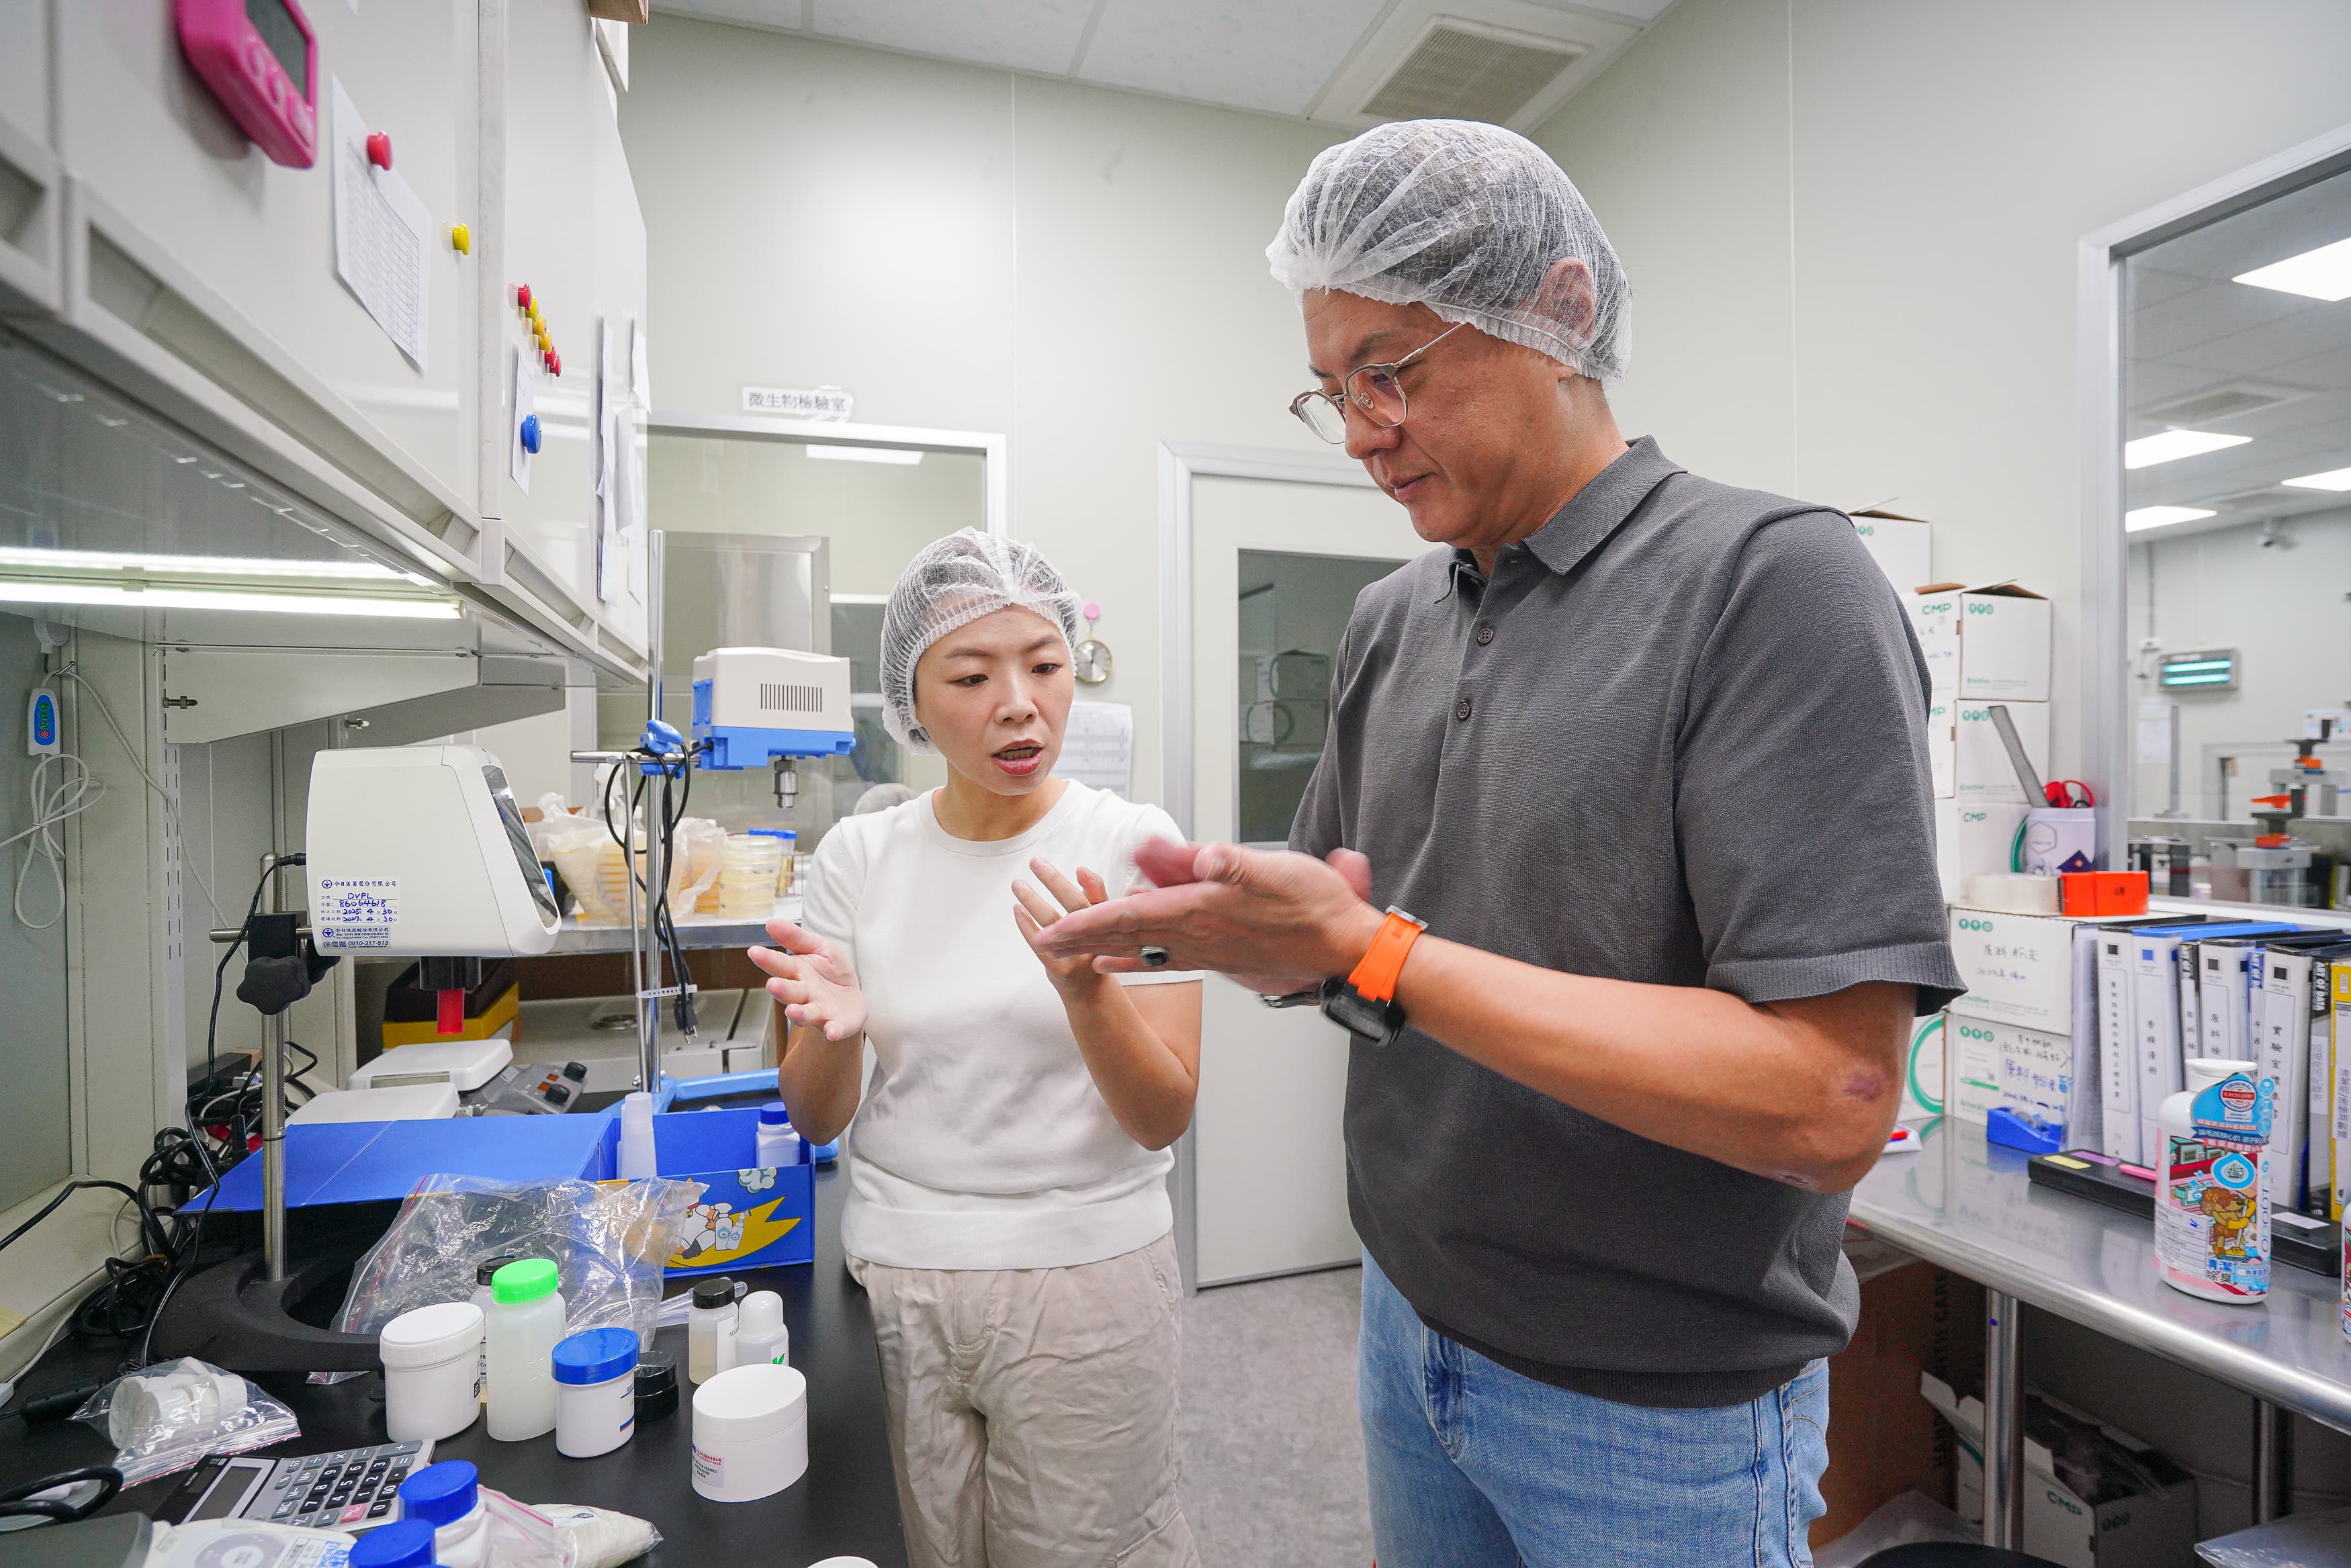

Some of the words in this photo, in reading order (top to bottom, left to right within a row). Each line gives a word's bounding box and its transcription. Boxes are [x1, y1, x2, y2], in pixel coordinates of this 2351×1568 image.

[749, 392, 846, 411] 微生物檢驗室
[1922, 603, 1952, 614] CMP
[1931, 706, 1946, 715] MP
[1963, 813, 1987, 823] CMP
[339, 899, 387, 907] 86064618
[2314, 962, 2325, 977] ART
[2314, 978, 2325, 989] OF
[2314, 991, 2325, 1011] DATA
[382, 1485, 396, 1494] 00
